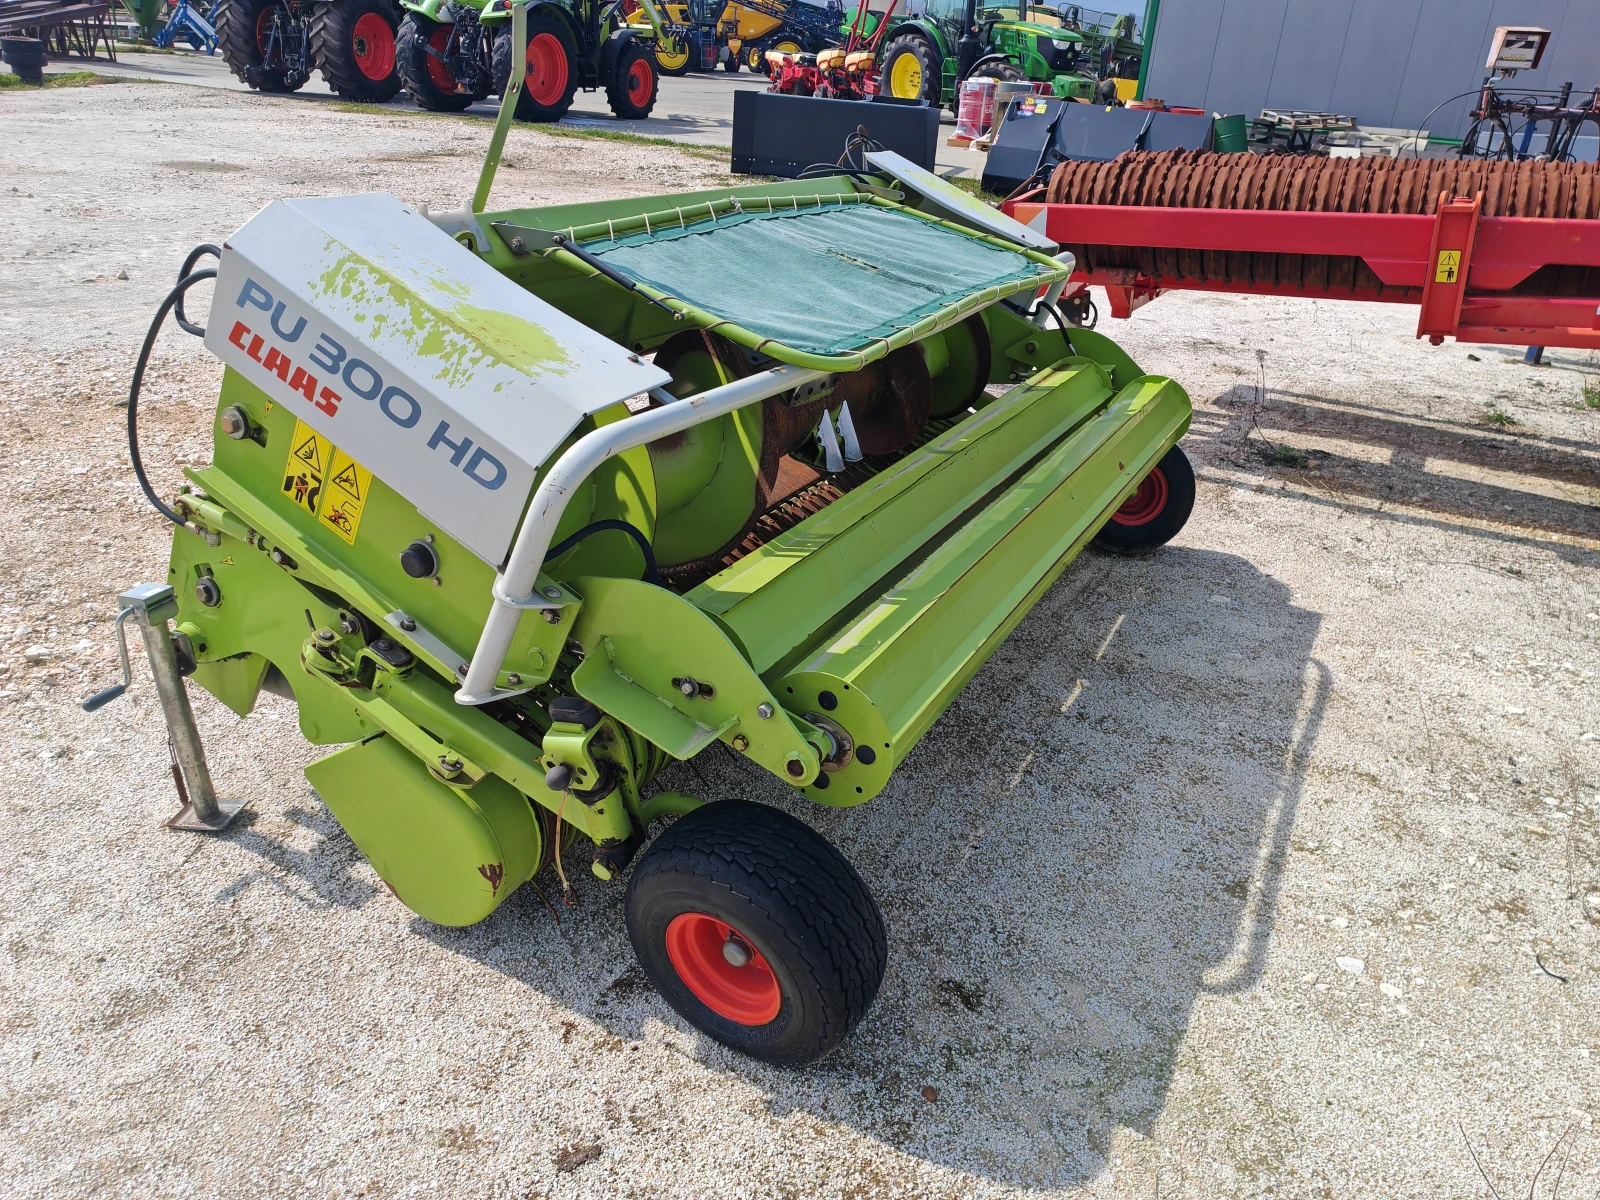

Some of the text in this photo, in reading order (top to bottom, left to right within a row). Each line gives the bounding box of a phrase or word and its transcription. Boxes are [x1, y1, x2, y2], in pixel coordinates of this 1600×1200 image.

[228, 320, 343, 418] CLAAS
[236, 278, 508, 490] PU 300 HD
